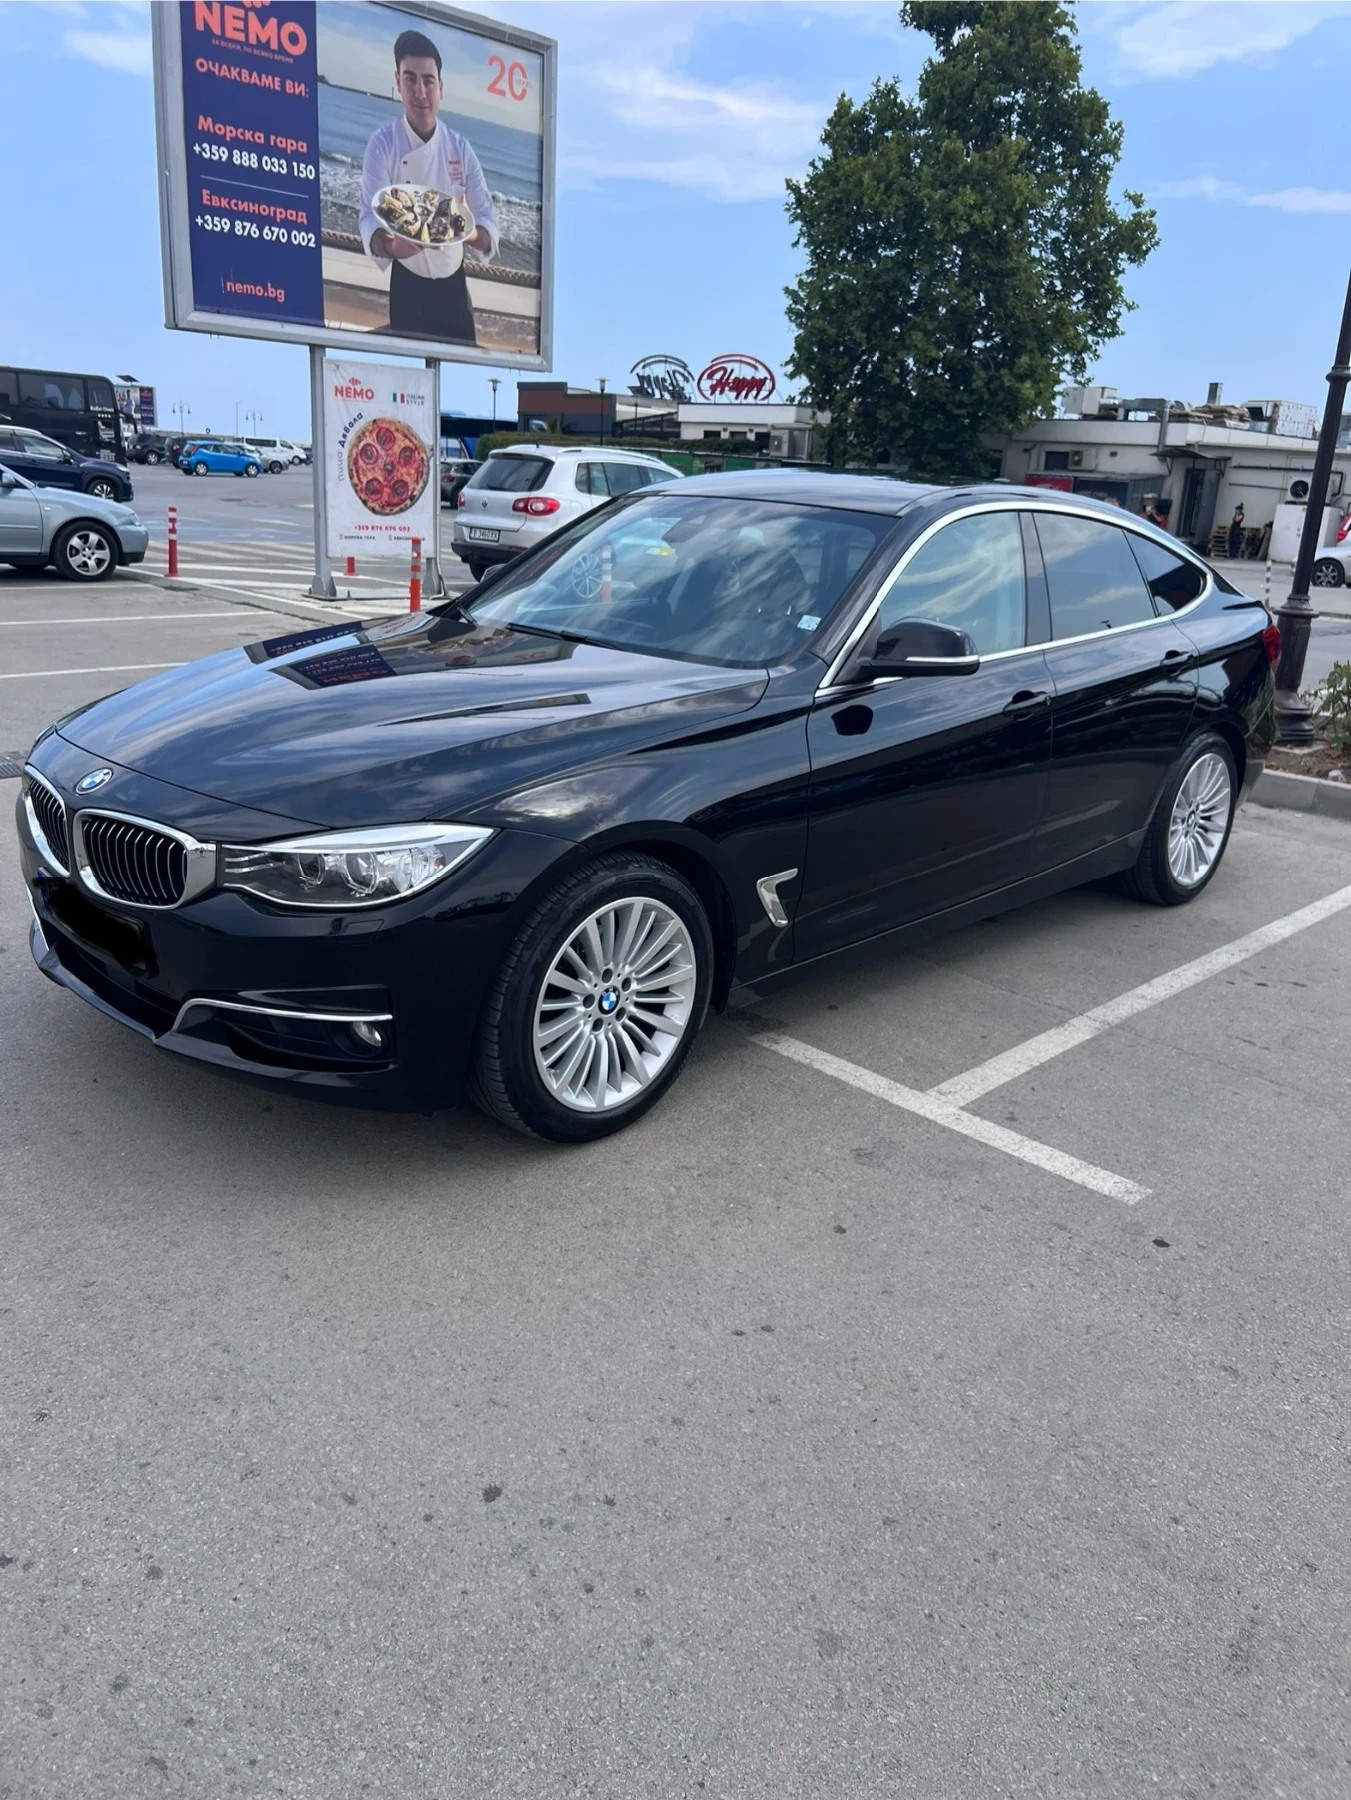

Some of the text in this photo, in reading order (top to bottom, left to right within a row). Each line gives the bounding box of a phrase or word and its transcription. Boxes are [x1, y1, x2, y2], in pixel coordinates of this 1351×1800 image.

[194, 1, 307, 56] NEMO
[195, 57, 310, 98] ОЧАКВАМЕ ВИ:
[198, 115, 307, 154] Морска гара
[193, 142, 316, 180] +359 888 033 150
[202, 189, 308, 225] Евксиноград
[195, 214, 316, 248] +359 876 670 002
[226, 280, 285, 302] nemo.bg
[334, 385, 375, 400] NEMO
[706, 366, 768, 400] Happy
